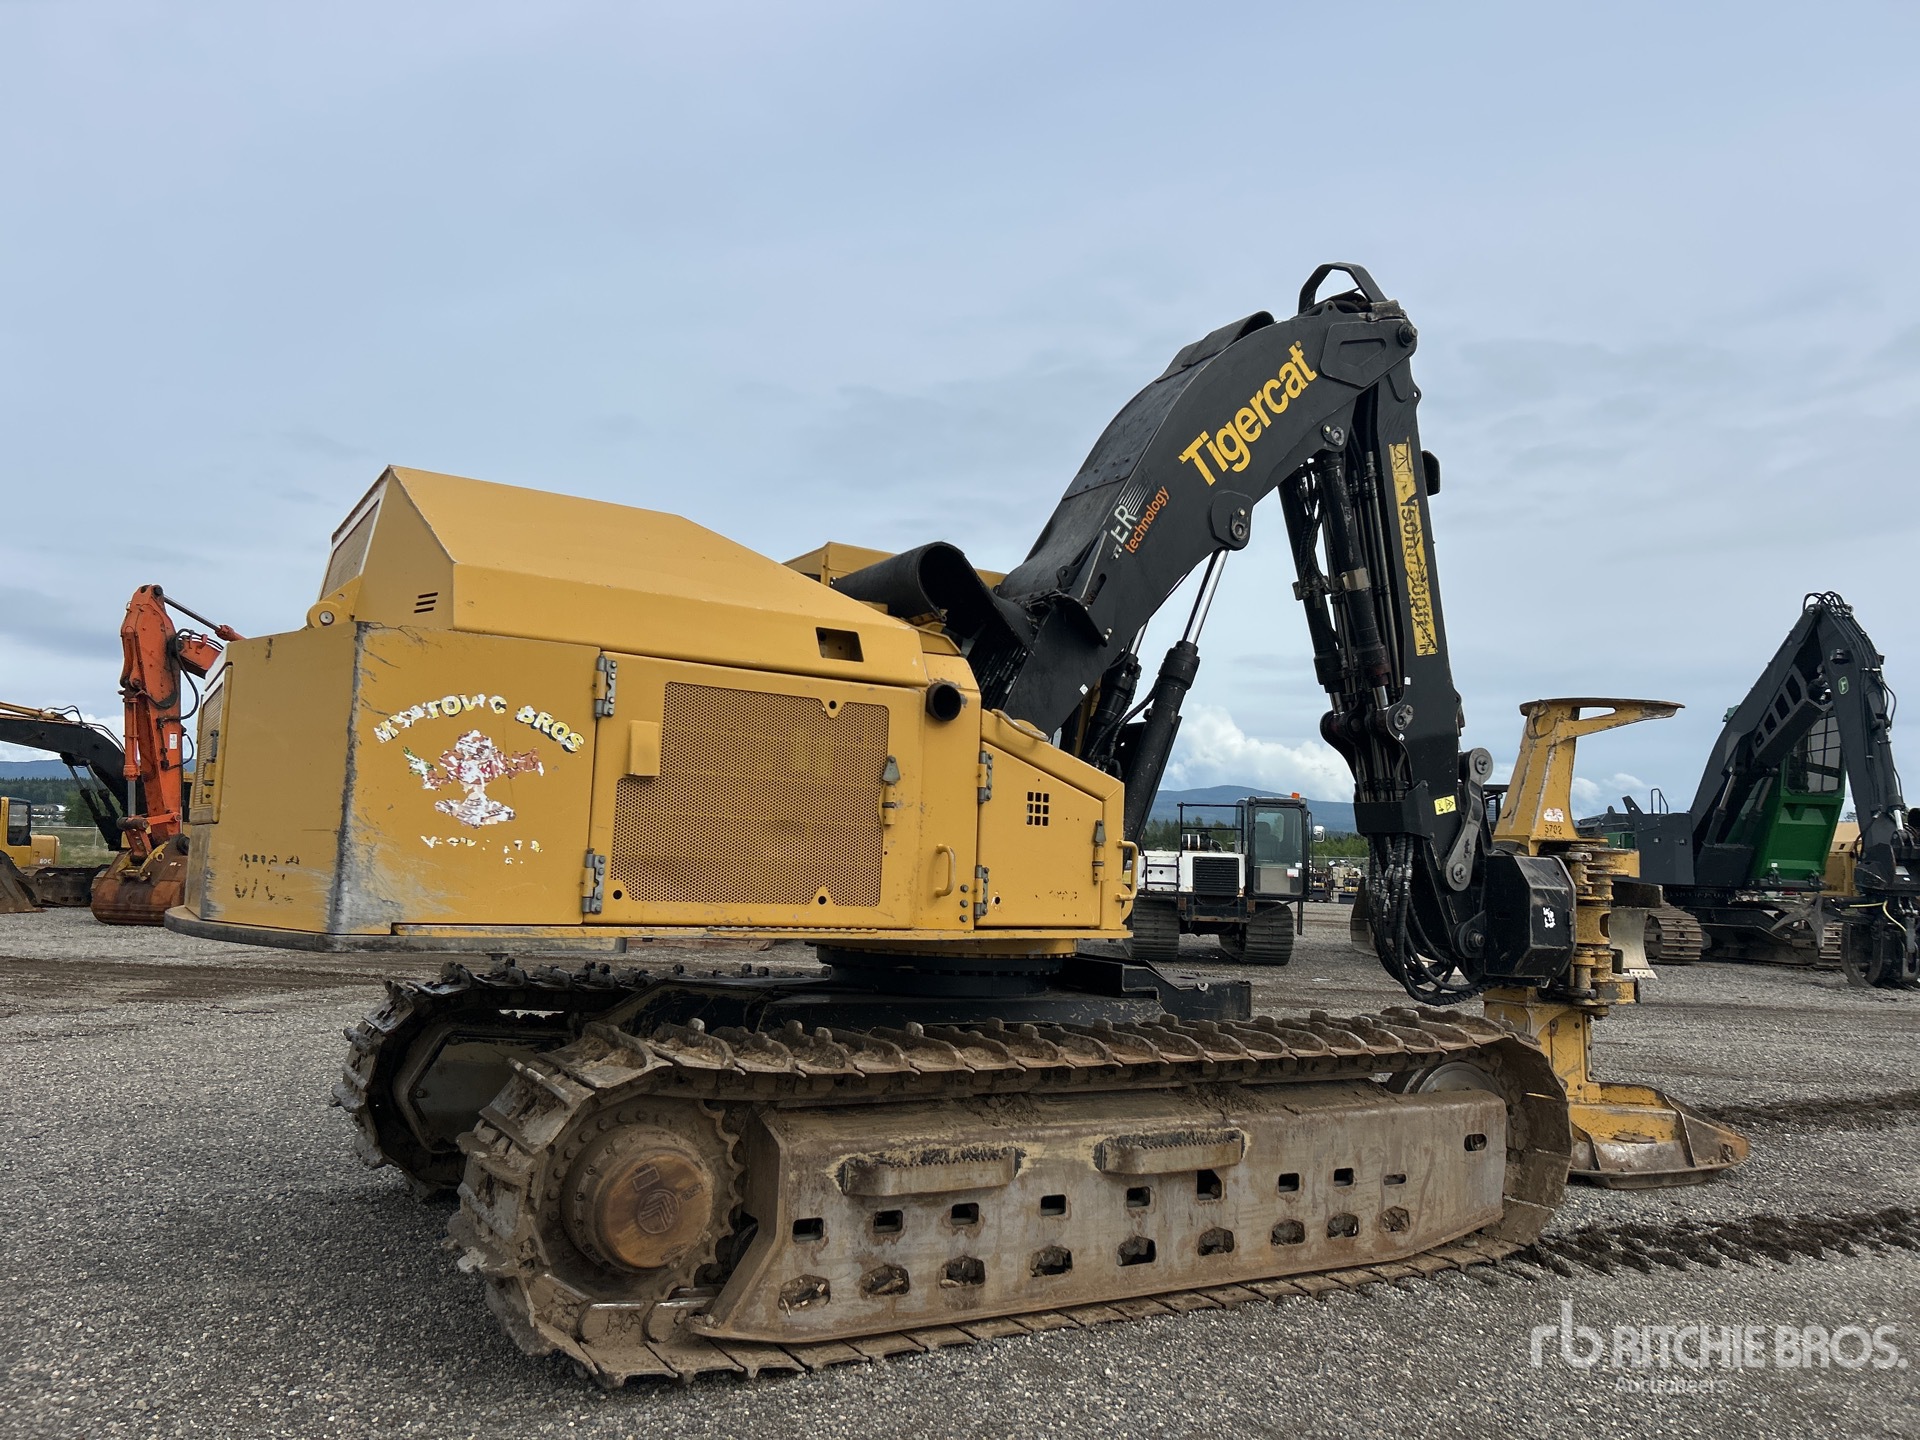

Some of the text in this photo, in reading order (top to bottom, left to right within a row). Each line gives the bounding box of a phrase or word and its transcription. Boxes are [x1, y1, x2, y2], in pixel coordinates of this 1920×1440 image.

[1178, 344, 1318, 487] Tigercat
[1124, 485, 1170, 554] technology
[515, 705, 585, 754] BROS
